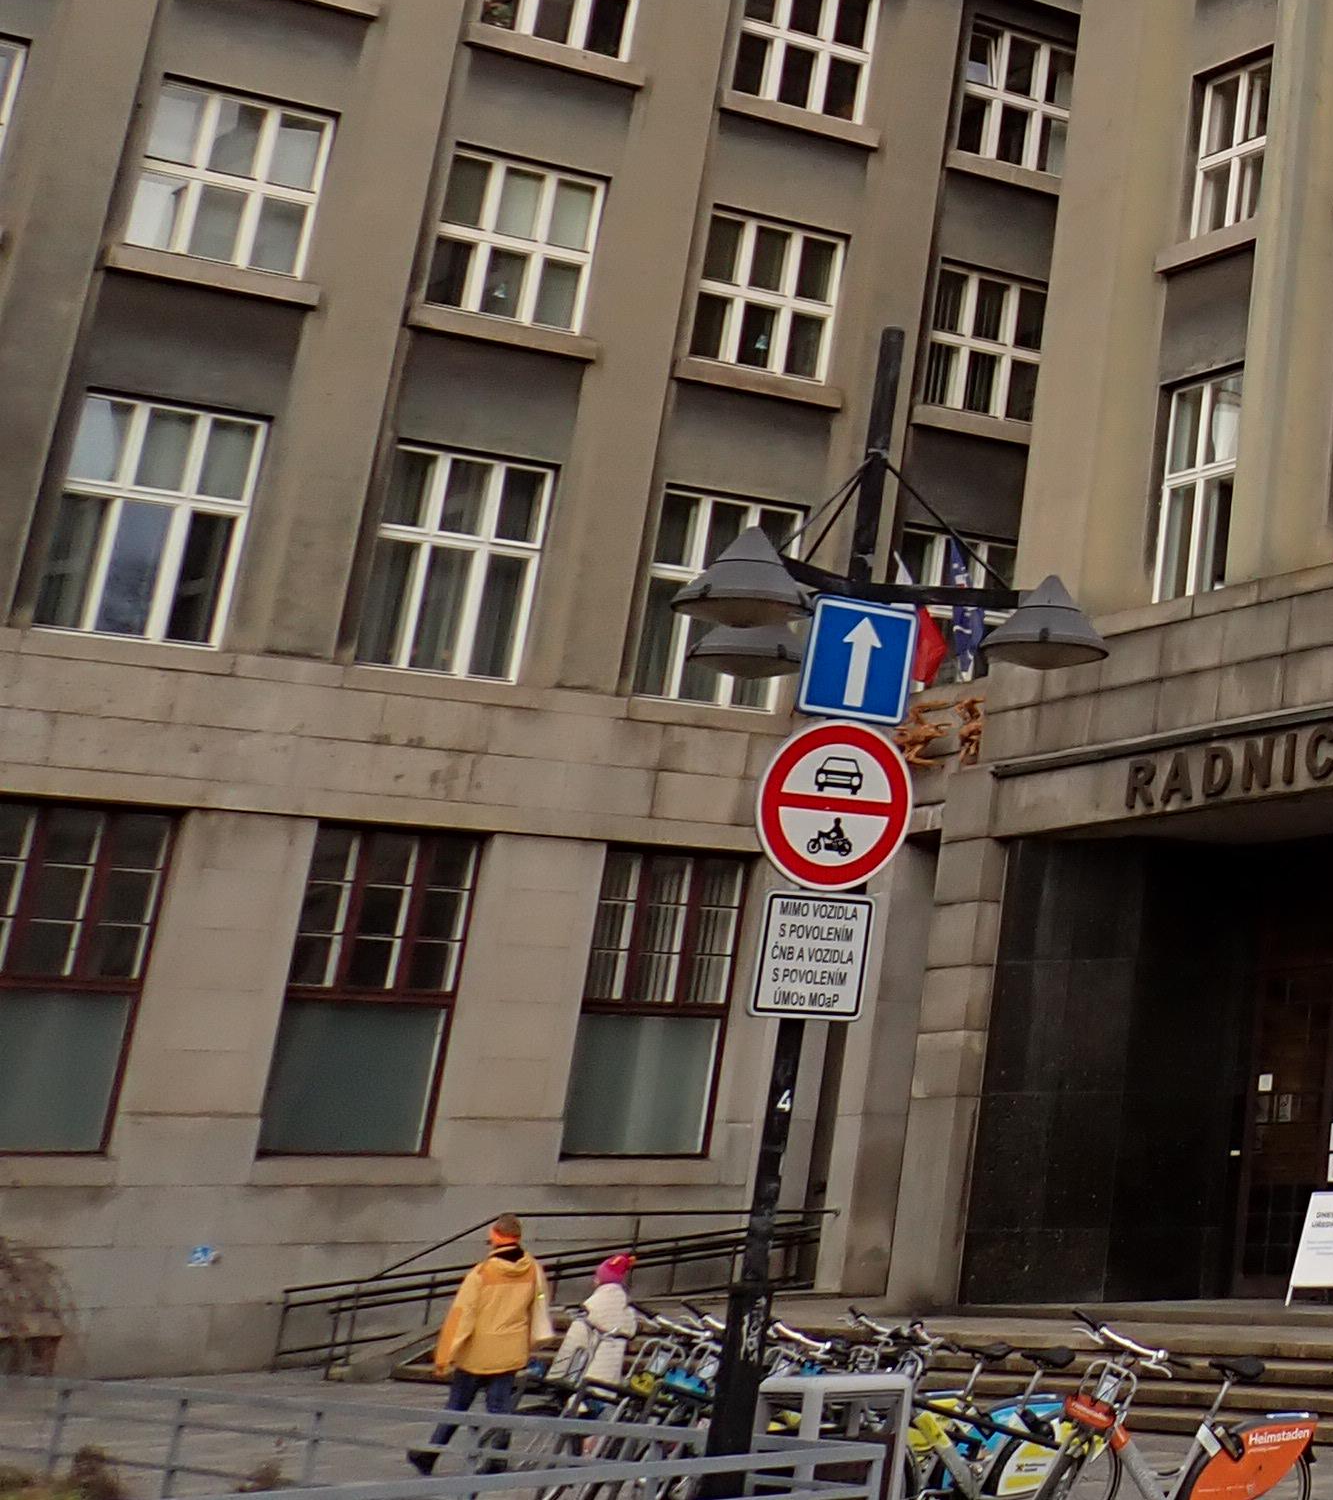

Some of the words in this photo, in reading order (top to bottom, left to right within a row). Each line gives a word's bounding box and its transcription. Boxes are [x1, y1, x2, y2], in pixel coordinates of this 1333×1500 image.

[780, 901, 810, 917] MIMO
[812, 903, 858, 920] VOZIDLA
[779, 923, 786, 938] S
[788, 923, 854, 942] POVOLENÍM
[771, 941, 795, 961] ČNB
[796, 947, 805, 962] A
[807, 947, 854, 965] VOZIDLA
[772, 967, 780, 983] S
[781, 968, 848, 986] POVOLENÍM
[773, 987, 806, 1006] ÚMOb
[807, 991, 840, 1008] MOaP
[776, 1089, 791, 1112] 4
[1248, 1427, 1311, 1446] Heimstaden
